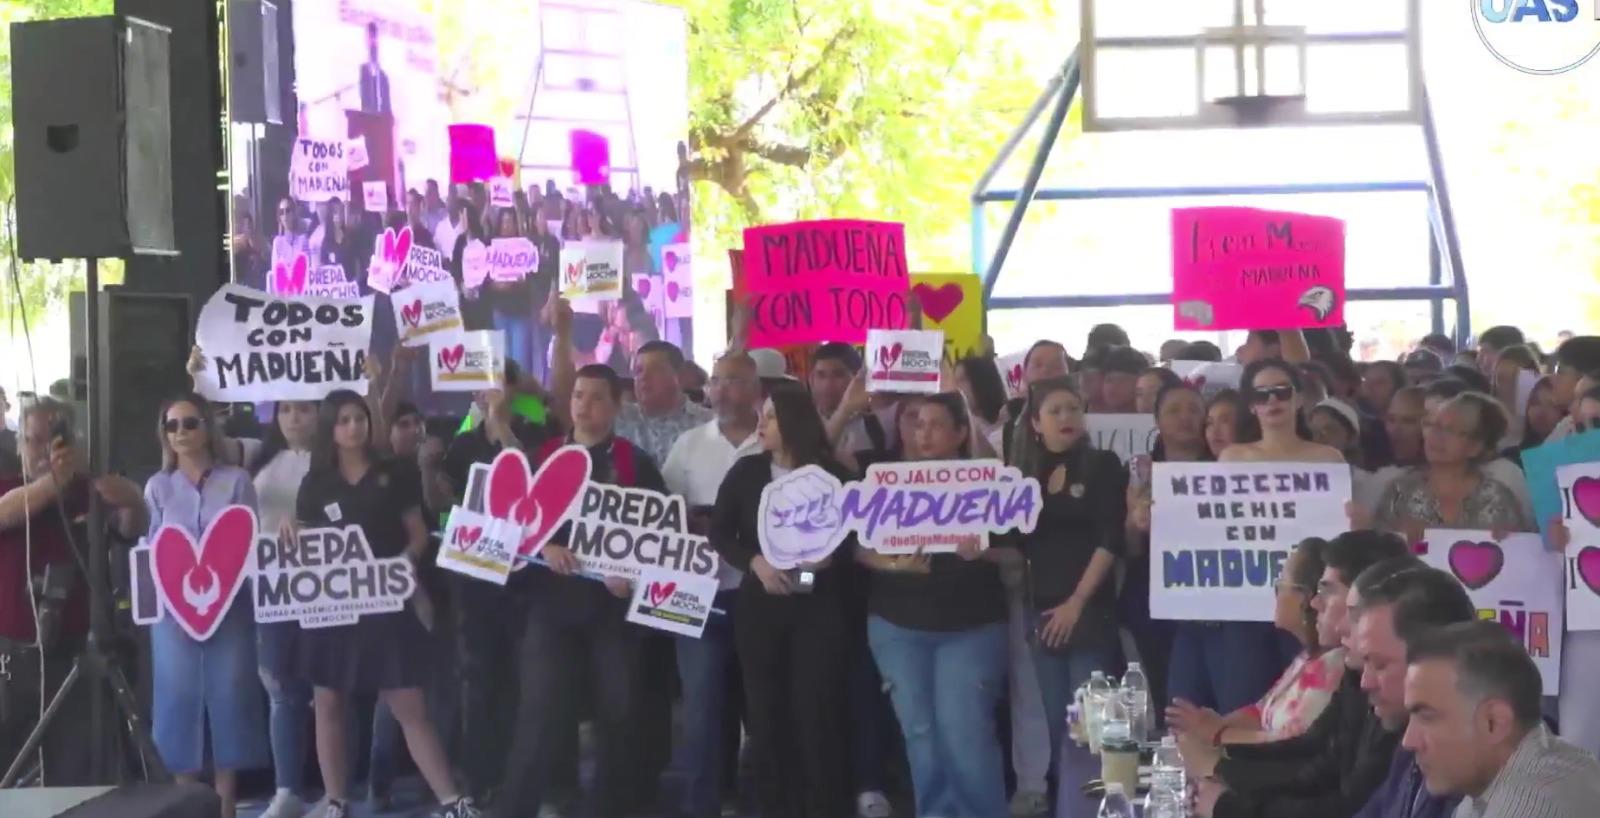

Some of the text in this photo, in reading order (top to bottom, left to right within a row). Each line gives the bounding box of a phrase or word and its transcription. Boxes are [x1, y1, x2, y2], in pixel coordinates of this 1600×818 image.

[300, 140, 343, 158] TODOS
[309, 162, 329, 172] CON
[763, 225, 902, 277] MADUEÑA
[309, 269, 343, 285] PREPA
[224, 292, 364, 327] TODOS
[753, 287, 906, 332] CON TODO
[247, 327, 312, 347] CON
[215, 341, 369, 388] MADUEÑA
[875, 467, 996, 485] YO JALO CON
[1171, 472, 1330, 496] MEDICINA
[581, 486, 682, 534] PREPA
[842, 475, 1034, 540] MADUEÑA
[1197, 501, 1296, 519] MOCHIS
[1563, 487, 1572, 519] I
[571, 521, 716, 577] MOCHIS
[1226, 525, 1276, 541] CON
[257, 531, 367, 570] PREPA
[258, 562, 410, 607] MOCHIS
[1570, 557, 1577, 590] I
[258, 610, 289, 618] UNIDAD
